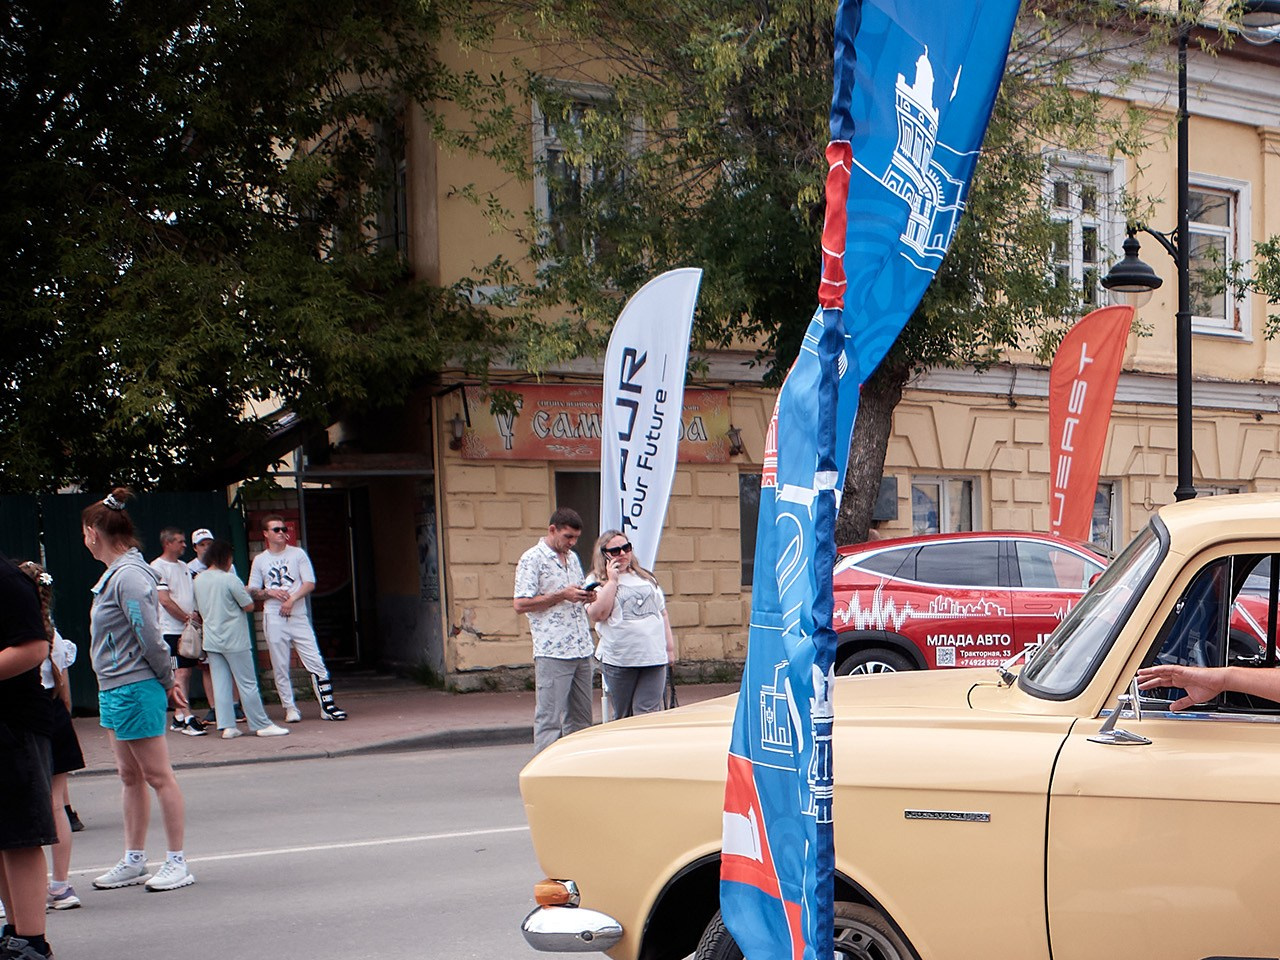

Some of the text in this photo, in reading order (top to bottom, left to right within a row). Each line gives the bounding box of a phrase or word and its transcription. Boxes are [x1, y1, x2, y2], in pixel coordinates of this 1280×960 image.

[636, 387, 668, 471] Future
[926, 634, 1011, 647] МЛАДА АВТО
[960, 650, 1001, 658] Тракторная,
